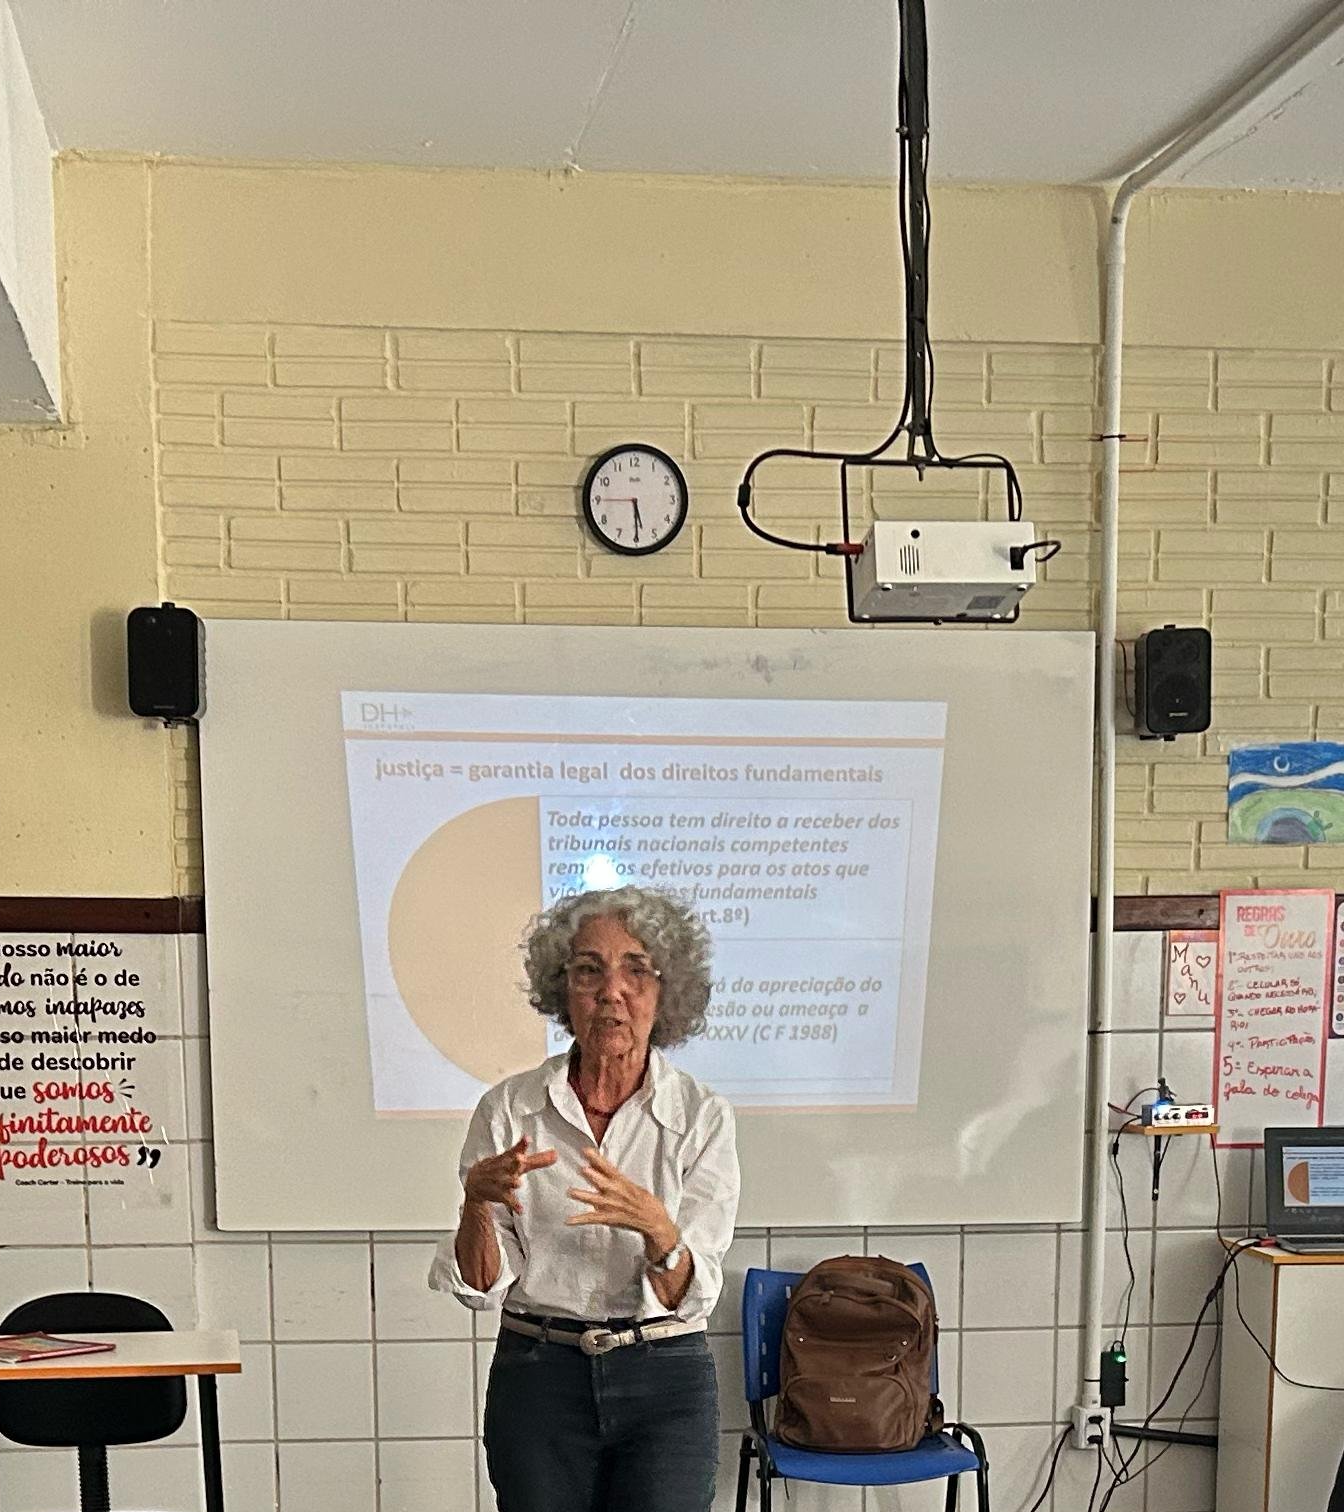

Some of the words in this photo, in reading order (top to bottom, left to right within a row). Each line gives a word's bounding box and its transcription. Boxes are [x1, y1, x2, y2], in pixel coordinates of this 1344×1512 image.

[612, 462, 622, 472] 11
[629, 457, 640, 468] 12
[599, 477, 610, 487] 10
[664, 476, 670, 486] 2
[595, 495, 601, 505] 9
[669, 494, 675, 505] 3
[601, 514, 607, 525] 8
[664, 514, 670, 524] 4
[616, 528, 622, 539] 7
[651, 529, 657, 539] 5
[375, 758, 444, 781] justiça
[468, 761, 554, 782] garantia
[560, 760, 607, 783] legal
[619, 762, 656, 781] dos
[662, 762, 738, 781] direitos
[744, 764, 884, 783] fundamentais
[547, 811, 593, 827] Toda
[598, 814, 664, 830] pessoa
[669, 813, 705, 828] tem
[710, 811, 772, 829] direito
[776, 816, 788, 829] a
[793, 812, 862, 829] receber
[867, 813, 900, 829] dos
[548, 835, 632, 851] tribunais
[637, 835, 725, 851] nacionais
[730, 837, 849, 856] competentes
[640, 859, 713, 879] efetivos
[717, 862, 761, 879] para
[766, 862, 786, 877] os
[791, 862, 831, 877] atos
[835, 863, 869, 880] que
[693, 883, 818, 900] fundamentais
[1236, 906, 1286, 922] REGRAS
[1257, 924, 1316, 949] Ouro
[56, 940, 123, 957] maior
[30, 969, 69, 987] não
[75, 969, 88, 987] é
[94, 973, 108, 987] o
[114, 969, 140, 987] de
[1172, 942, 1211, 1005] Manu
[758, 976, 856, 996] apreciação
[859, 976, 882, 993] do
[45, 997, 145, 1022] incapazes
[751, 1004, 773, 1017] ou
[778, 1004, 849, 1021] ameaça
[857, 1004, 869, 1016] a
[31, 1026, 92, 1044] maior
[97, 1026, 157, 1044] medo
[788, 1024, 837, 1044] 1988)
[31, 1052, 136, 1070] descobrir
[1303, 1068, 1313, 1078] a
[32, 1081, 115, 1104] somos
[1224, 1079, 1256, 1101] fala
